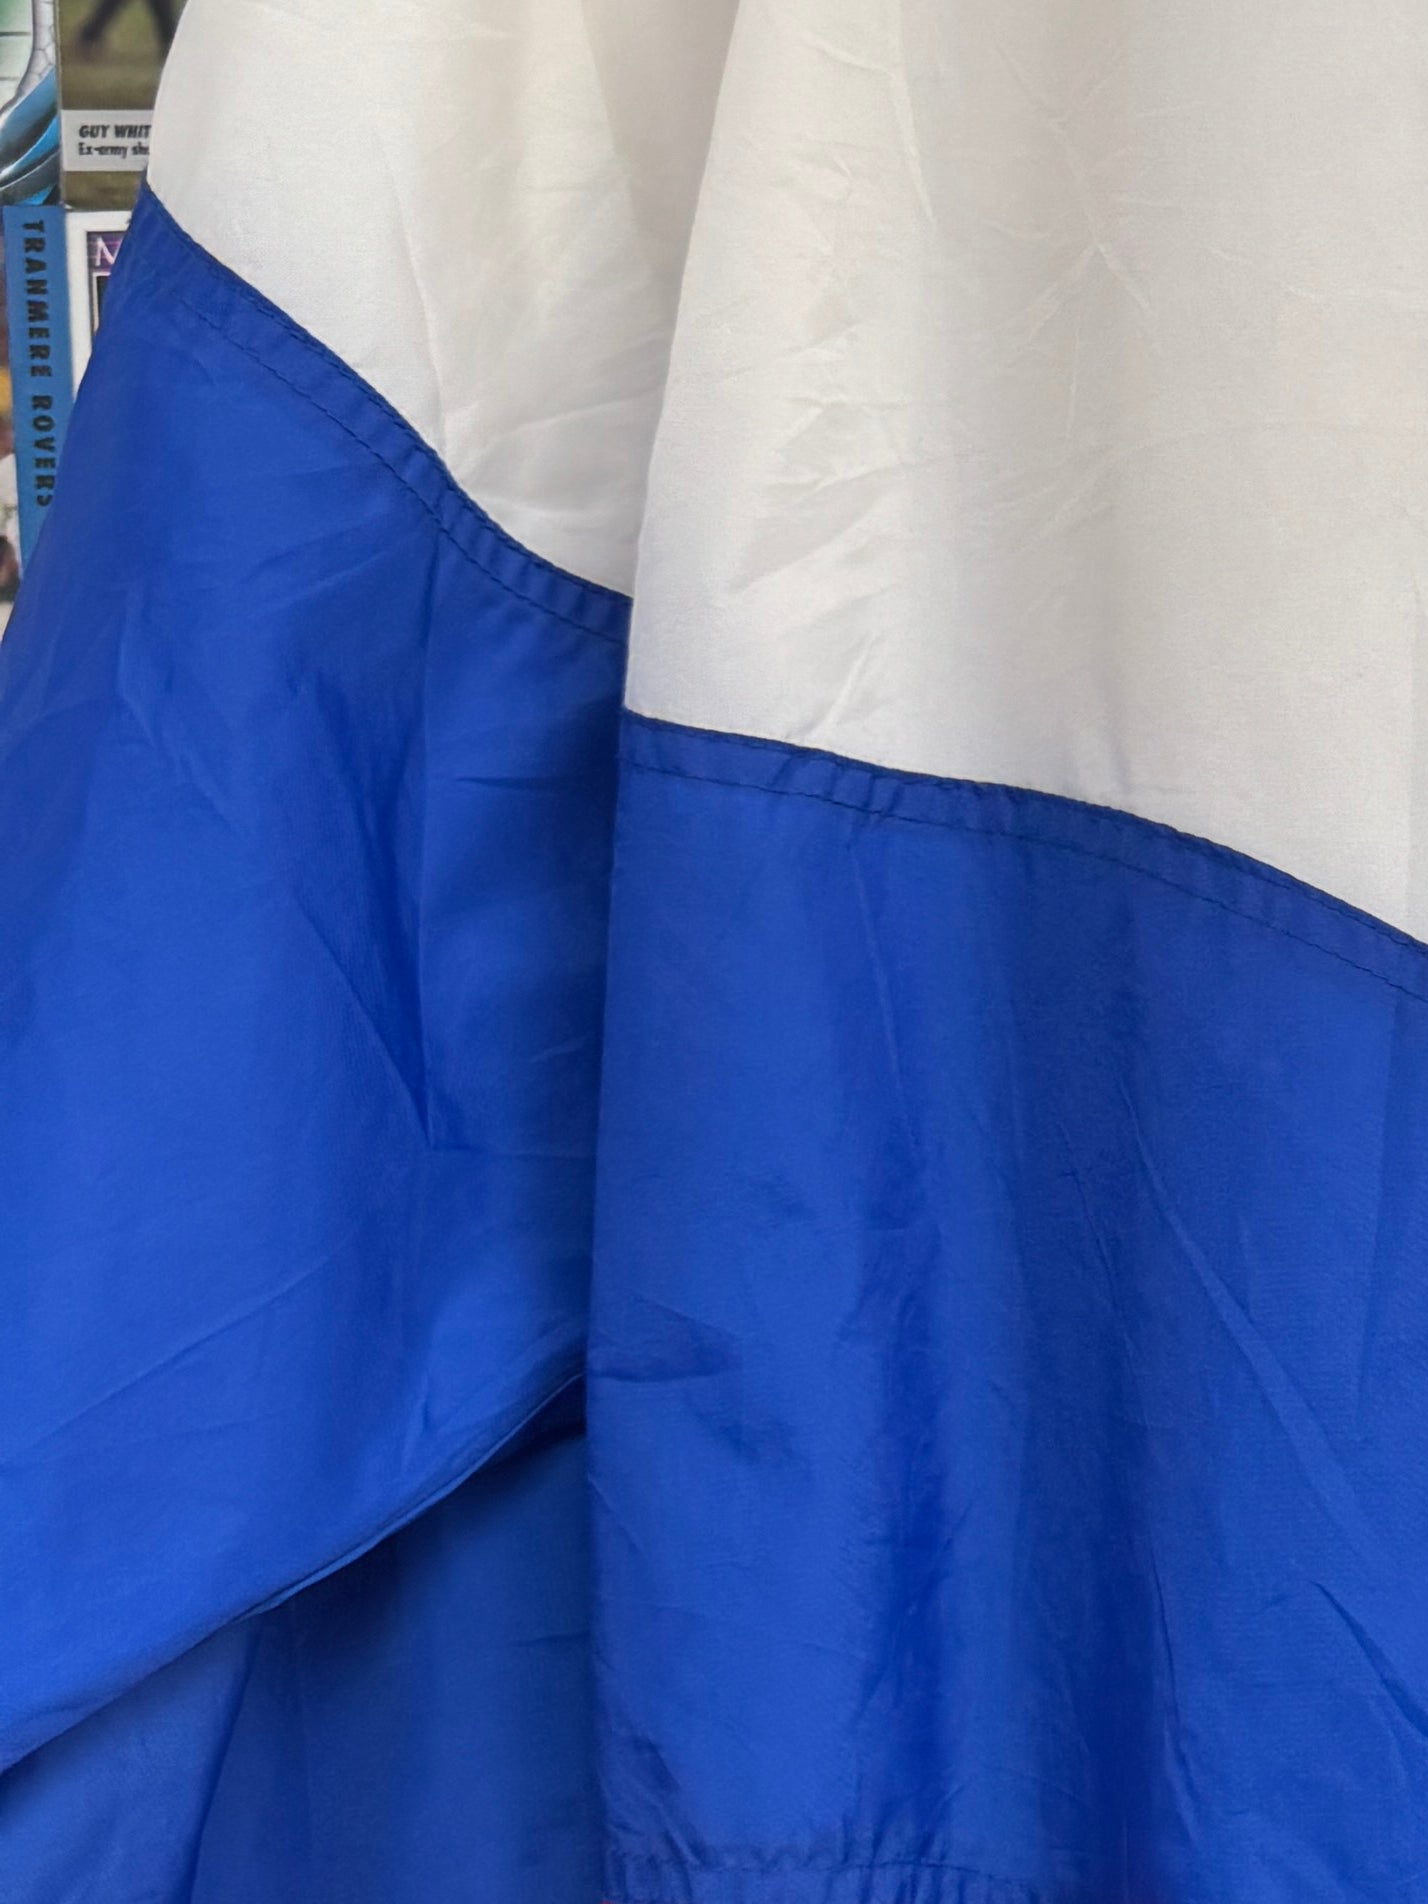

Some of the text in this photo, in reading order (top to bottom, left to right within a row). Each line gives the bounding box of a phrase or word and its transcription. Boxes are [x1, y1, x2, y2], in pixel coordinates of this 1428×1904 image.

[79, 125, 109, 138] GUY
[78, 143, 127, 159] Ex-army
[22, 219, 53, 377] TRANMERE
